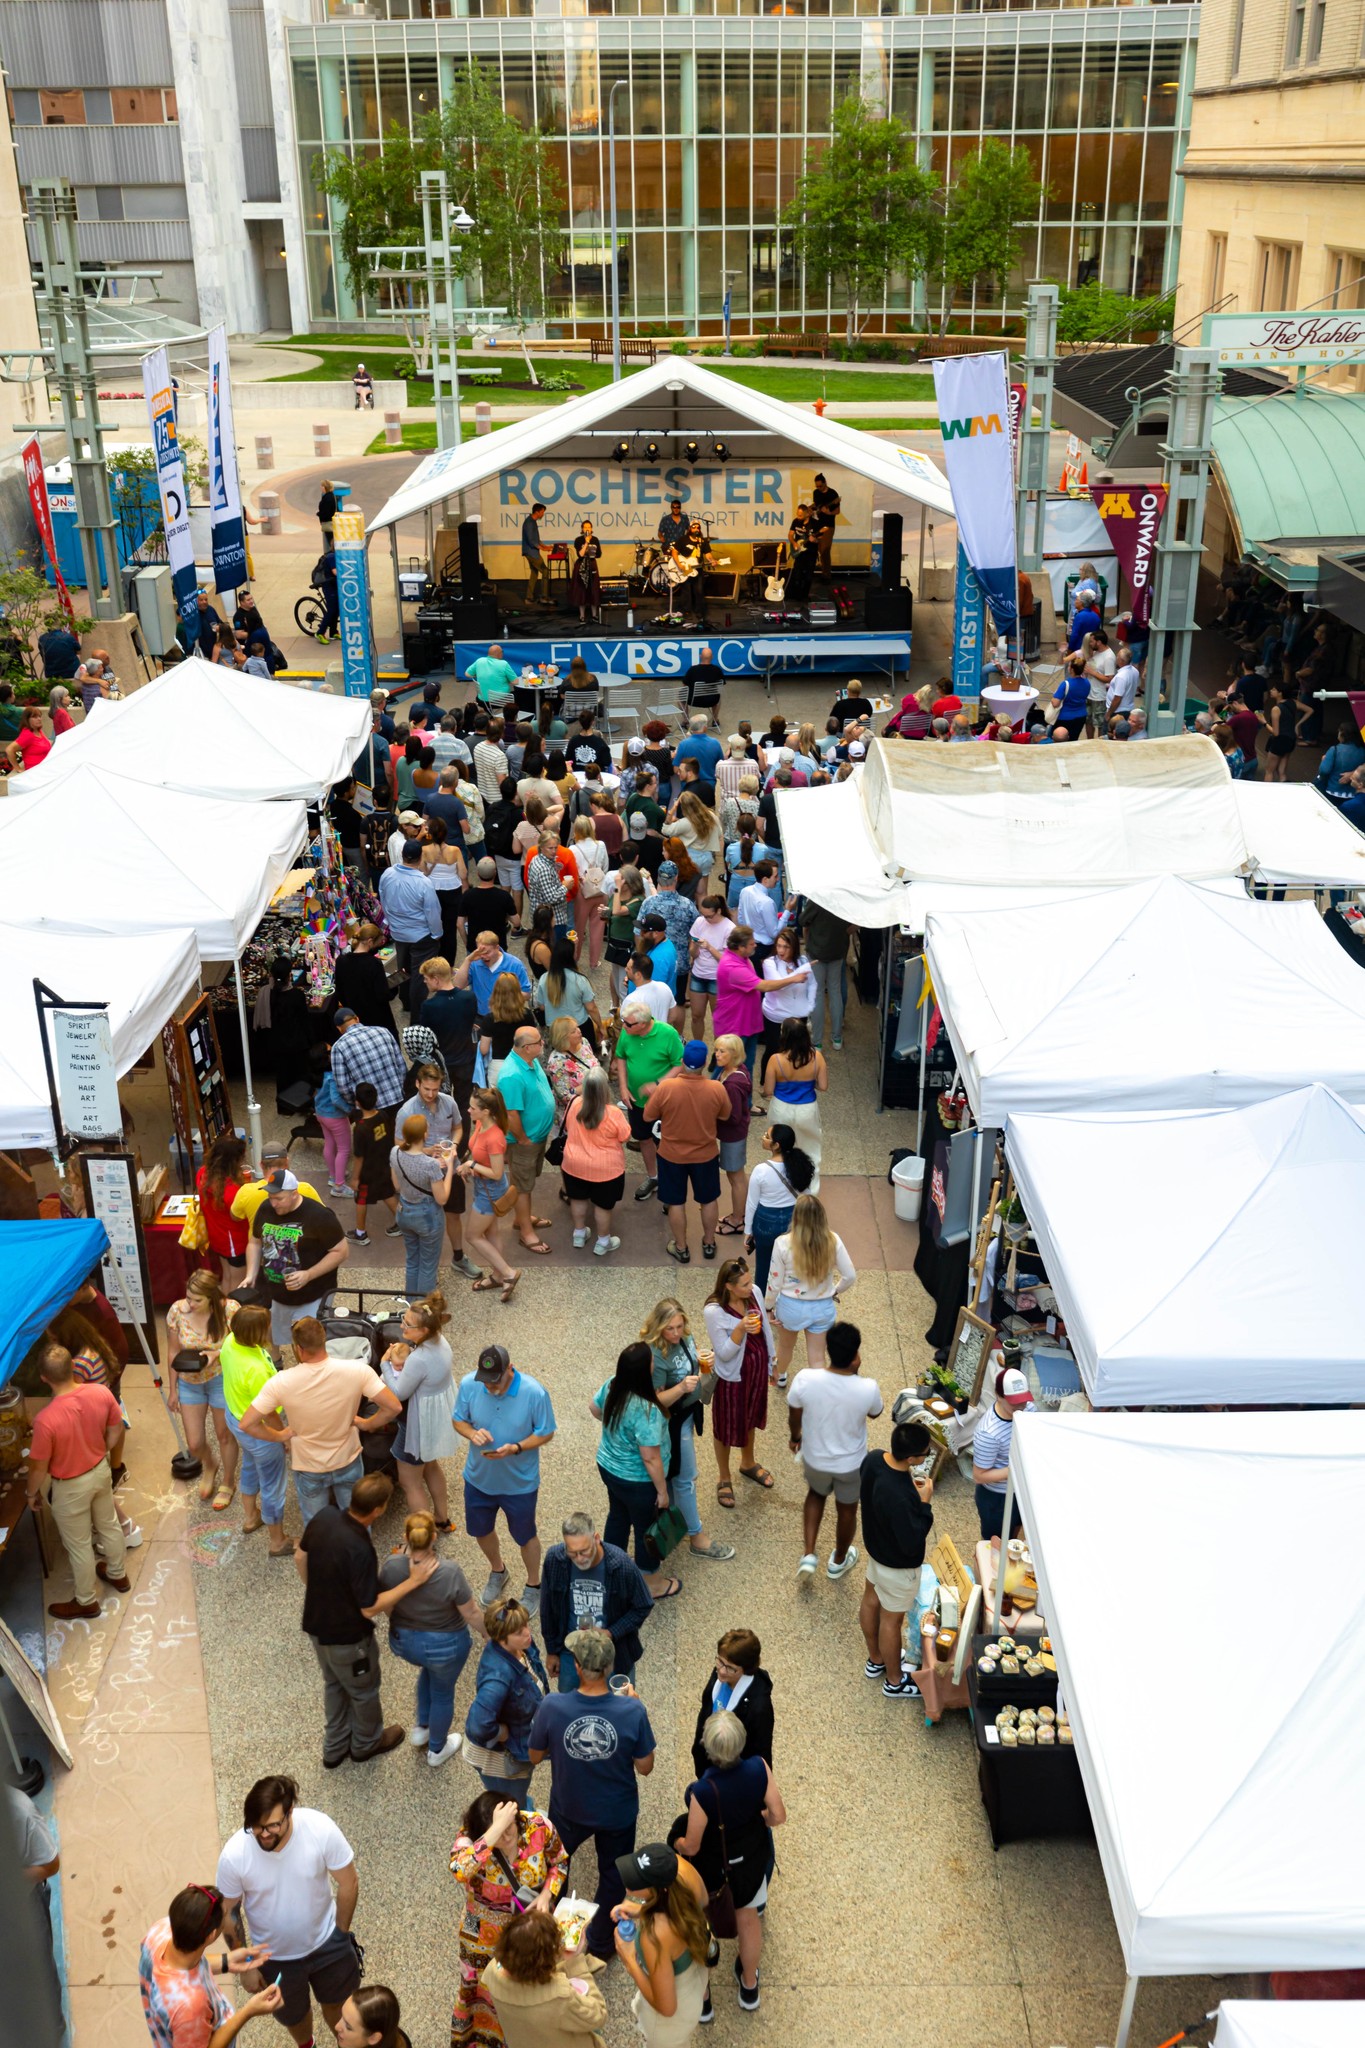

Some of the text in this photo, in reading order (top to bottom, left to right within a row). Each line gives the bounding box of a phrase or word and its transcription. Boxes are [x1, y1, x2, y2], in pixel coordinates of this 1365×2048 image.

[1250, 318, 1365, 351] The Kahler
[1220, 351, 1295, 361] GRAND
[940, 413, 1003, 441] WM
[499, 467, 784, 505] ROCHESTER
[1097, 493, 1136, 519] M
[500, 511, 785, 528] INTRNATIONAL APORT MN
[1133, 493, 1158, 588] ONWARD
[340, 560, 368, 698] FLYRST.COM
[956, 566, 981, 687] FLYRST.CO
[550, 639, 815, 675] FYRSTCOM
[66, 1032, 97, 1040] JEWELRY
[68, 1021, 91, 1030] SPIRIT
[69, 1062, 101, 1071] PAINTING
[71, 1053, 96, 1061] HENNA
[78, 1084, 96, 1092] HAIR
[82, 1124, 102, 1132] BAGS
[373, 1122, 387, 1141] 21
[573, 1593, 604, 1608] RUN
[109, 1559, 179, 1691] Baker's Dozen
[158, 1614, 198, 1649] $17
